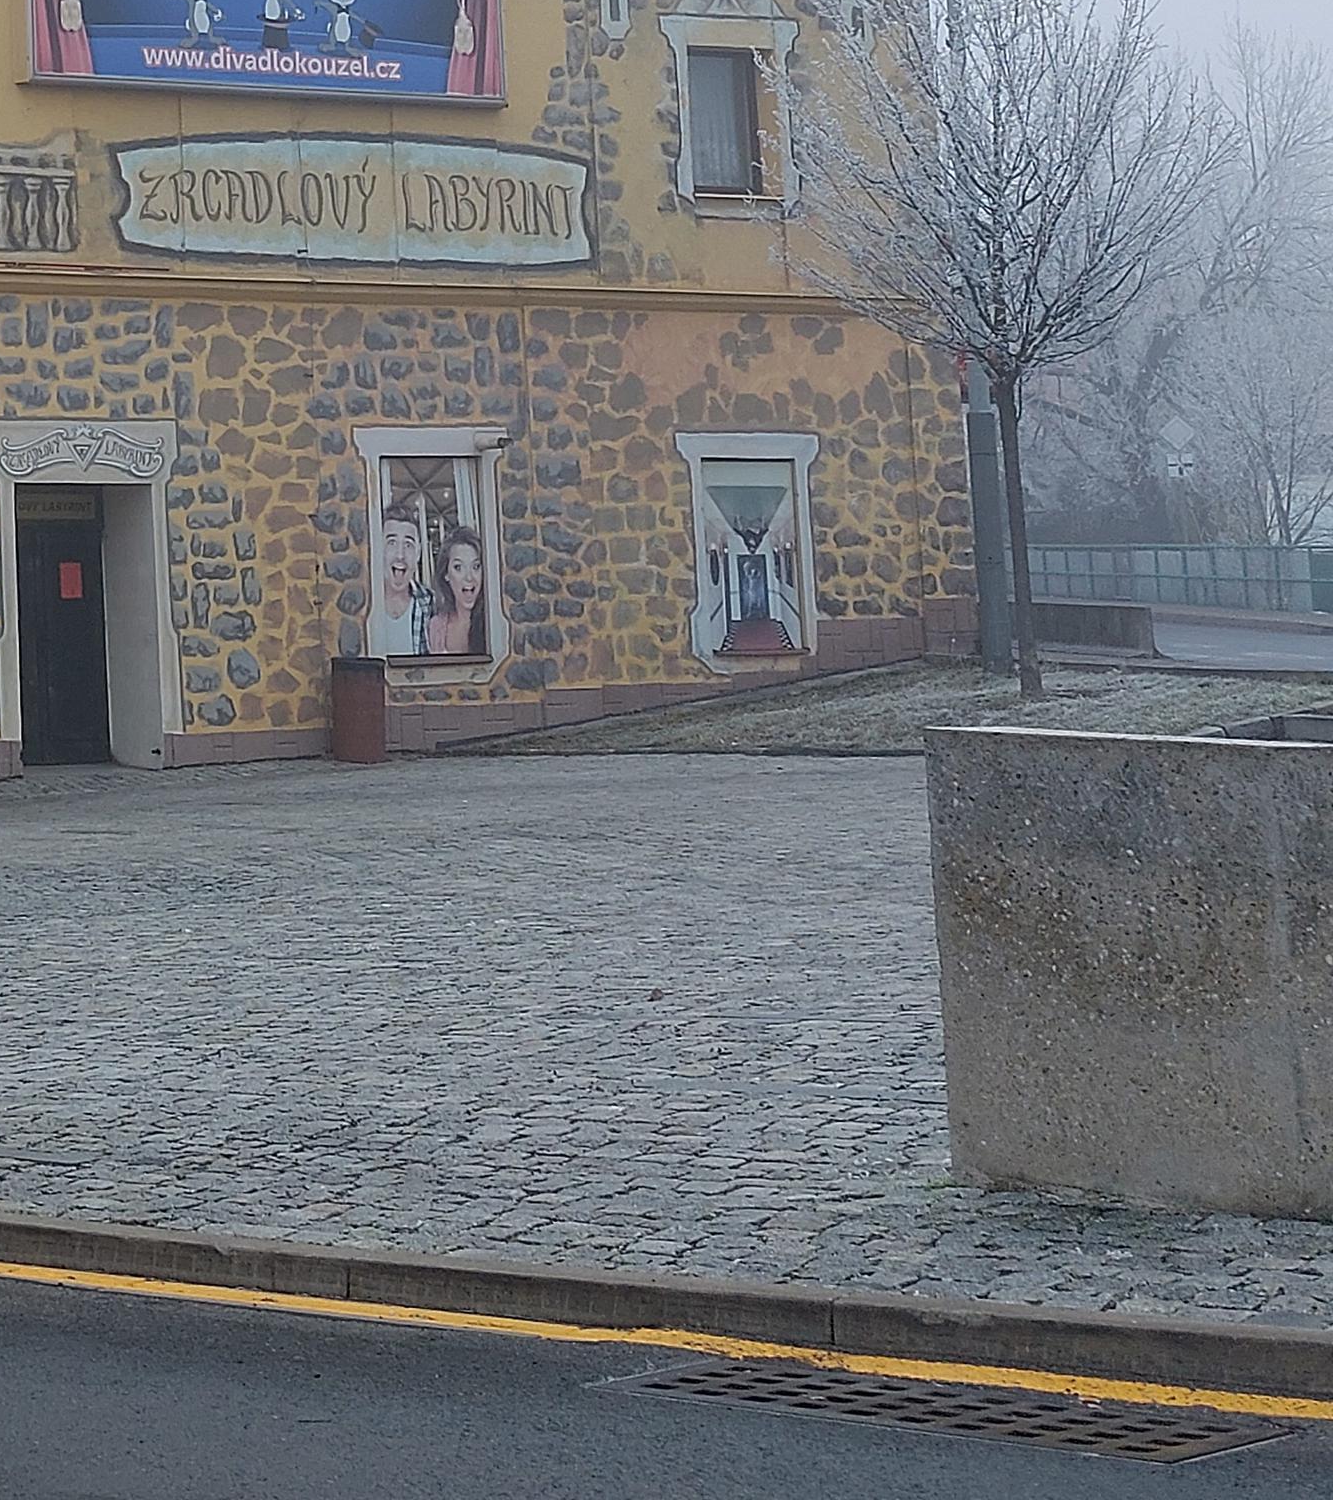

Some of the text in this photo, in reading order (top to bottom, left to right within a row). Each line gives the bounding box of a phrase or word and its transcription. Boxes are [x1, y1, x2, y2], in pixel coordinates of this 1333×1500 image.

[143, 46, 403, 81] www.divadlokouzel.cz
[137, 156, 576, 240] ZRCADLOVÝ LABYRINT
